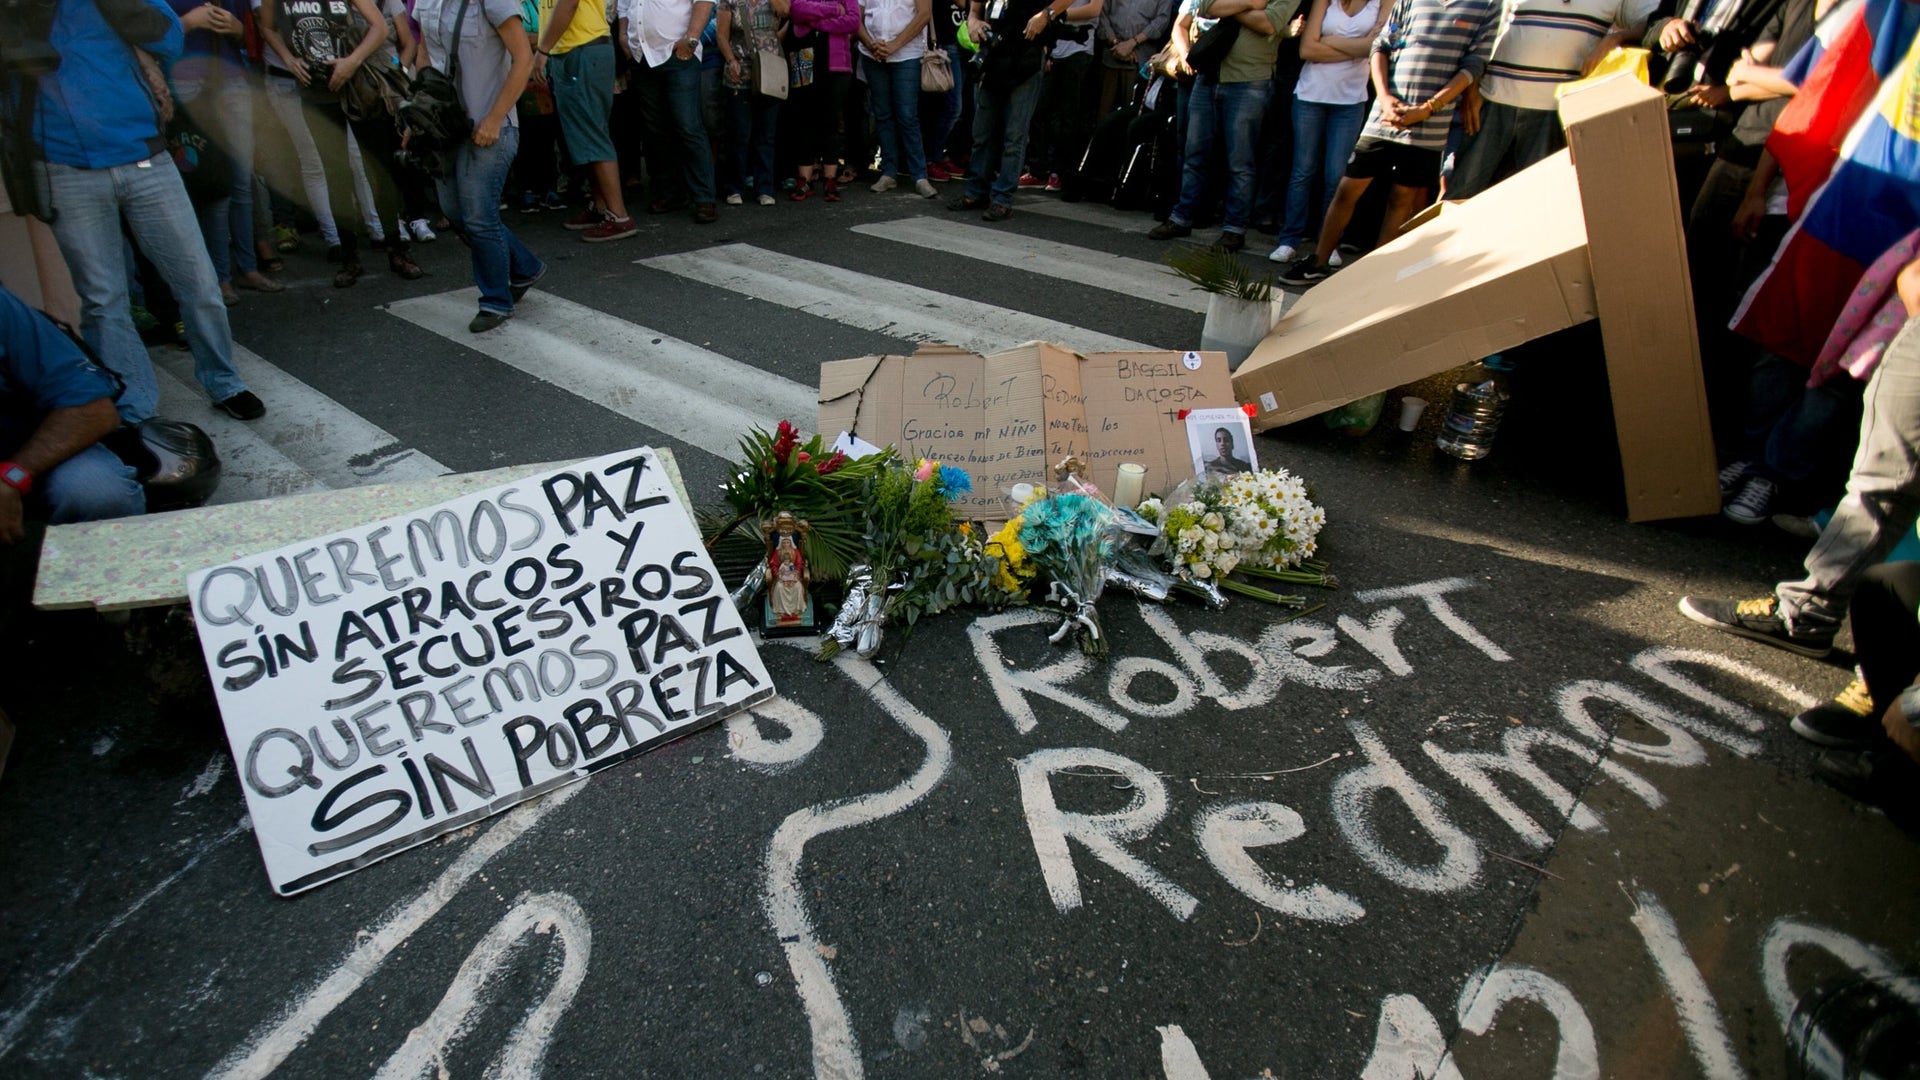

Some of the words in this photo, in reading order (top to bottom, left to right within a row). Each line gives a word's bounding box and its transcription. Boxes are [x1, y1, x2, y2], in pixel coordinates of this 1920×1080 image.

[903, 419, 964, 441] Gracias
[1118, 359, 1187, 380] BASSIL
[199, 488, 545, 627] QUEREMOS
[541, 456, 670, 536] PAZ
[334, 543, 583, 661] ATRACOS
[606, 521, 645, 573] Y
[245, 634, 619, 798] QUEREMOS
[619, 596, 742, 675] PAZ
[324, 551, 714, 710] SECUESTROS
[1007, 645, 1822, 923] Redman
